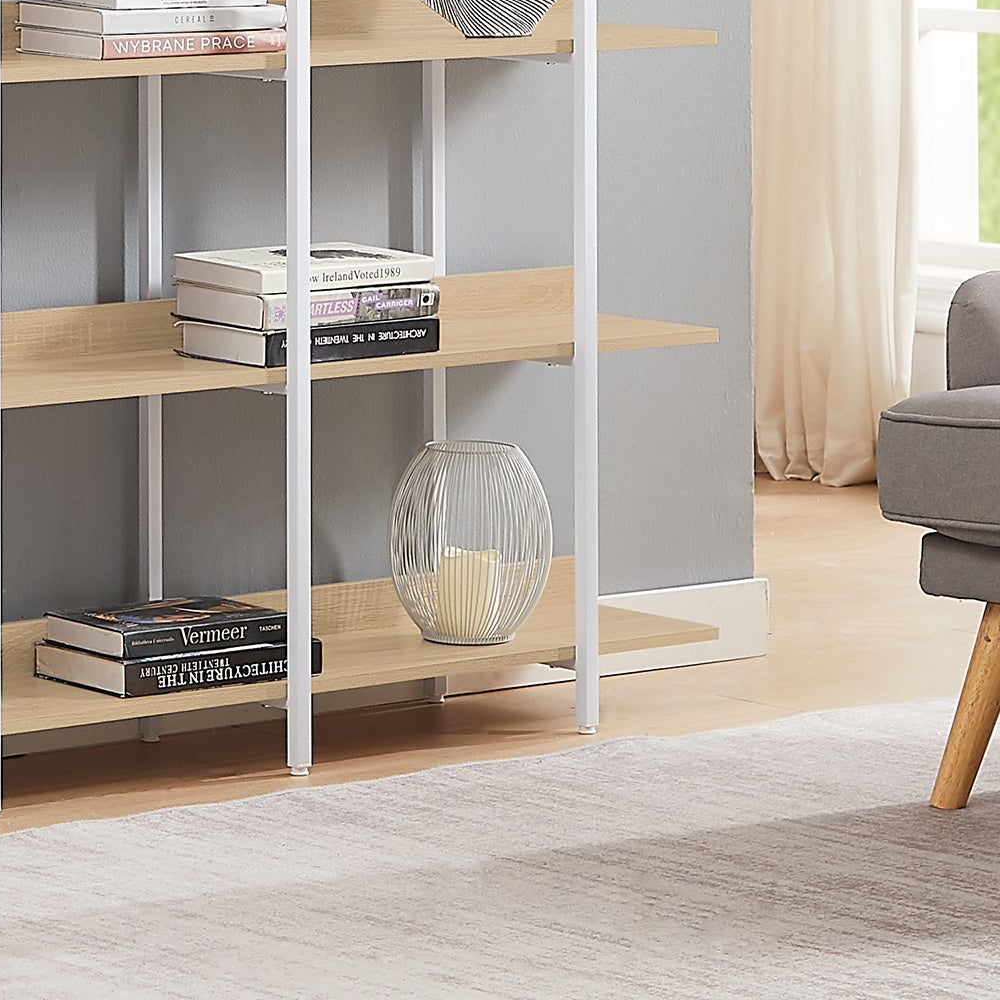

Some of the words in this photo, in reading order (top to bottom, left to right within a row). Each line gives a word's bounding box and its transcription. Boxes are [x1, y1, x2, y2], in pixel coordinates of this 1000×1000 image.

[174, 15, 206, 24] CEREAL
[112, 38, 195, 54] WYBRANE
[201, 35, 256, 51] PRACE
[361, 295, 381, 304] GAIL
[375, 300, 414, 310] CARRIGER
[311, 299, 355, 316] ARTLESS
[352, 335, 365, 343] THE
[378, 329, 427, 341] ARCHITECTURE
[259, 624, 282, 632] TASCHEN
[180, 625, 248, 646] Vermeer
[140, 664, 178, 678] CENTURY
[207, 659, 289, 682] CHITECYURE
[158, 673, 187, 688] THE
[188, 671, 204, 684] IN
